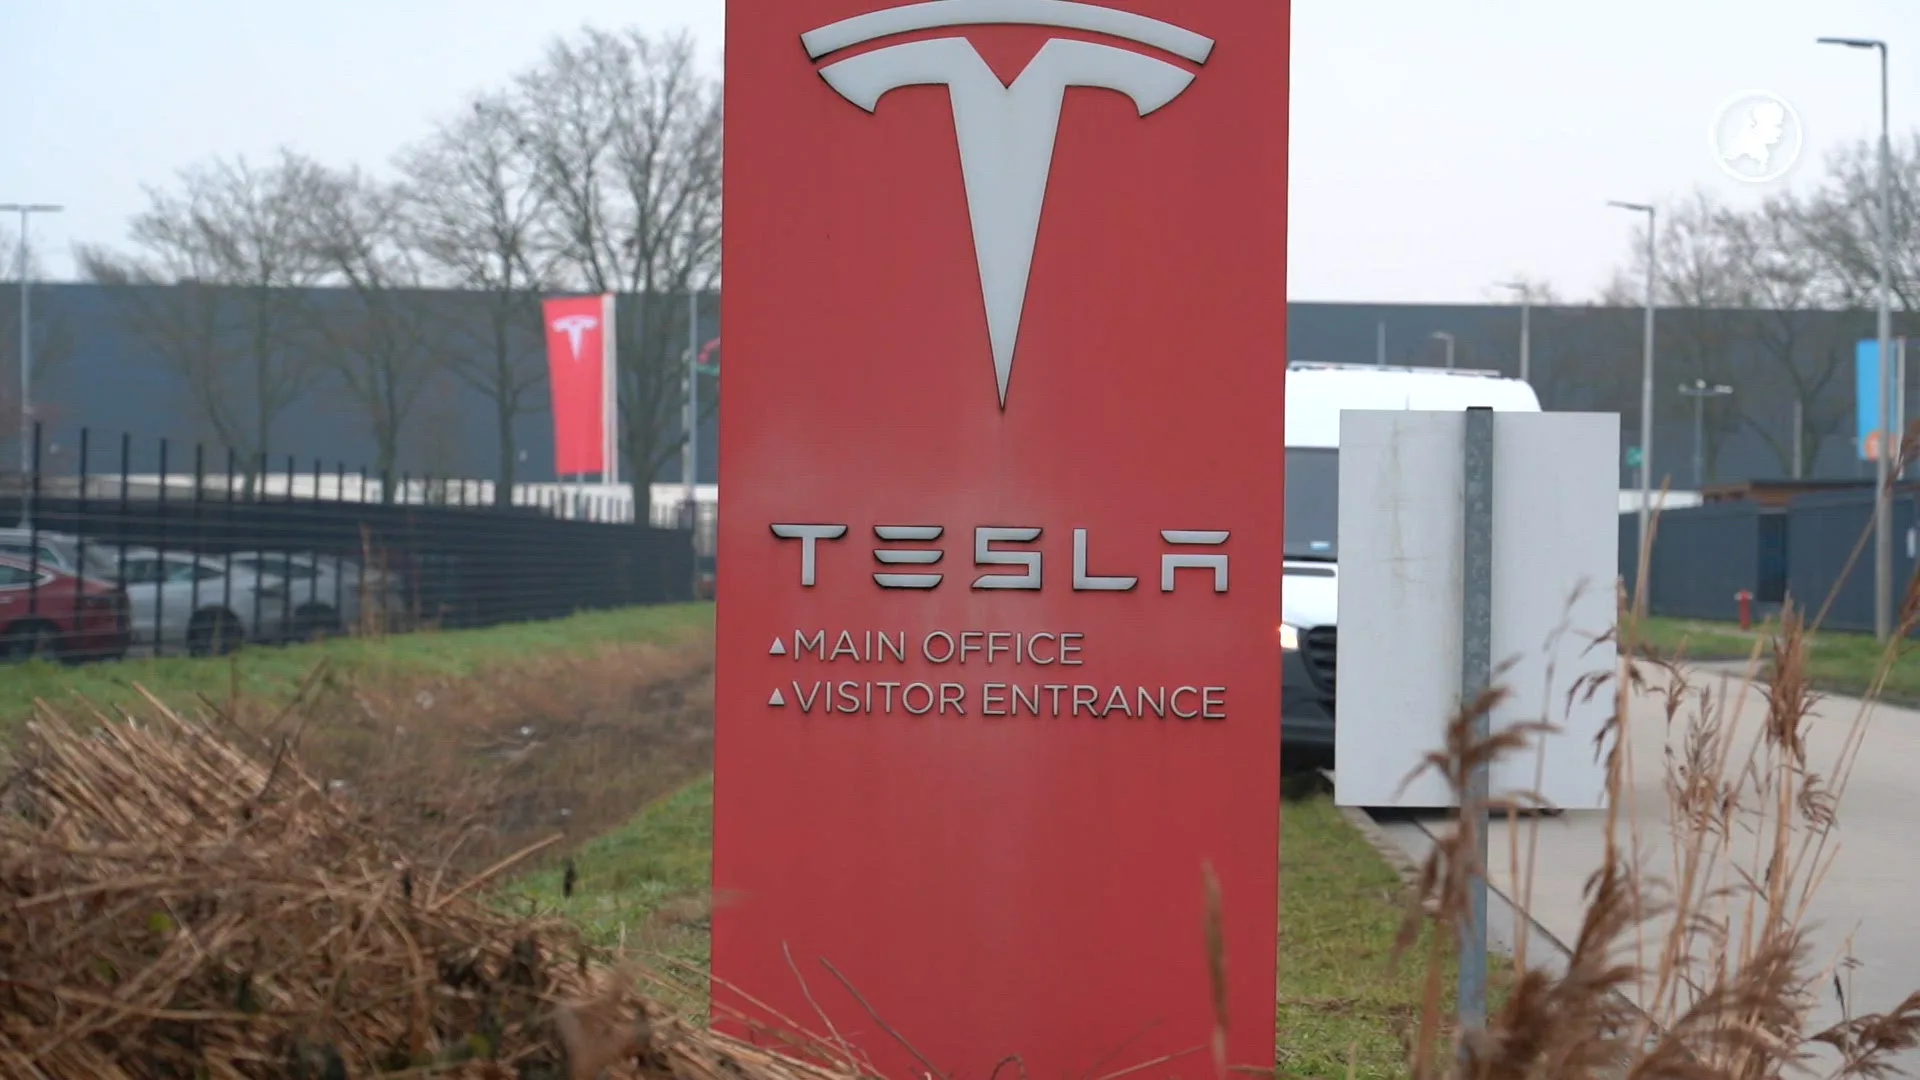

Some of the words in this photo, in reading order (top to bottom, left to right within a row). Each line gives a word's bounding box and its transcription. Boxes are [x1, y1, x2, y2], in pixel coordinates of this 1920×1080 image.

[769, 523, 1231, 592] TESLA
[793, 629, 906, 663] MAIN
[922, 631, 1085, 665] OFFICE
[792, 680, 965, 715] VISITOR
[982, 683, 1227, 719] ENTRANCE
